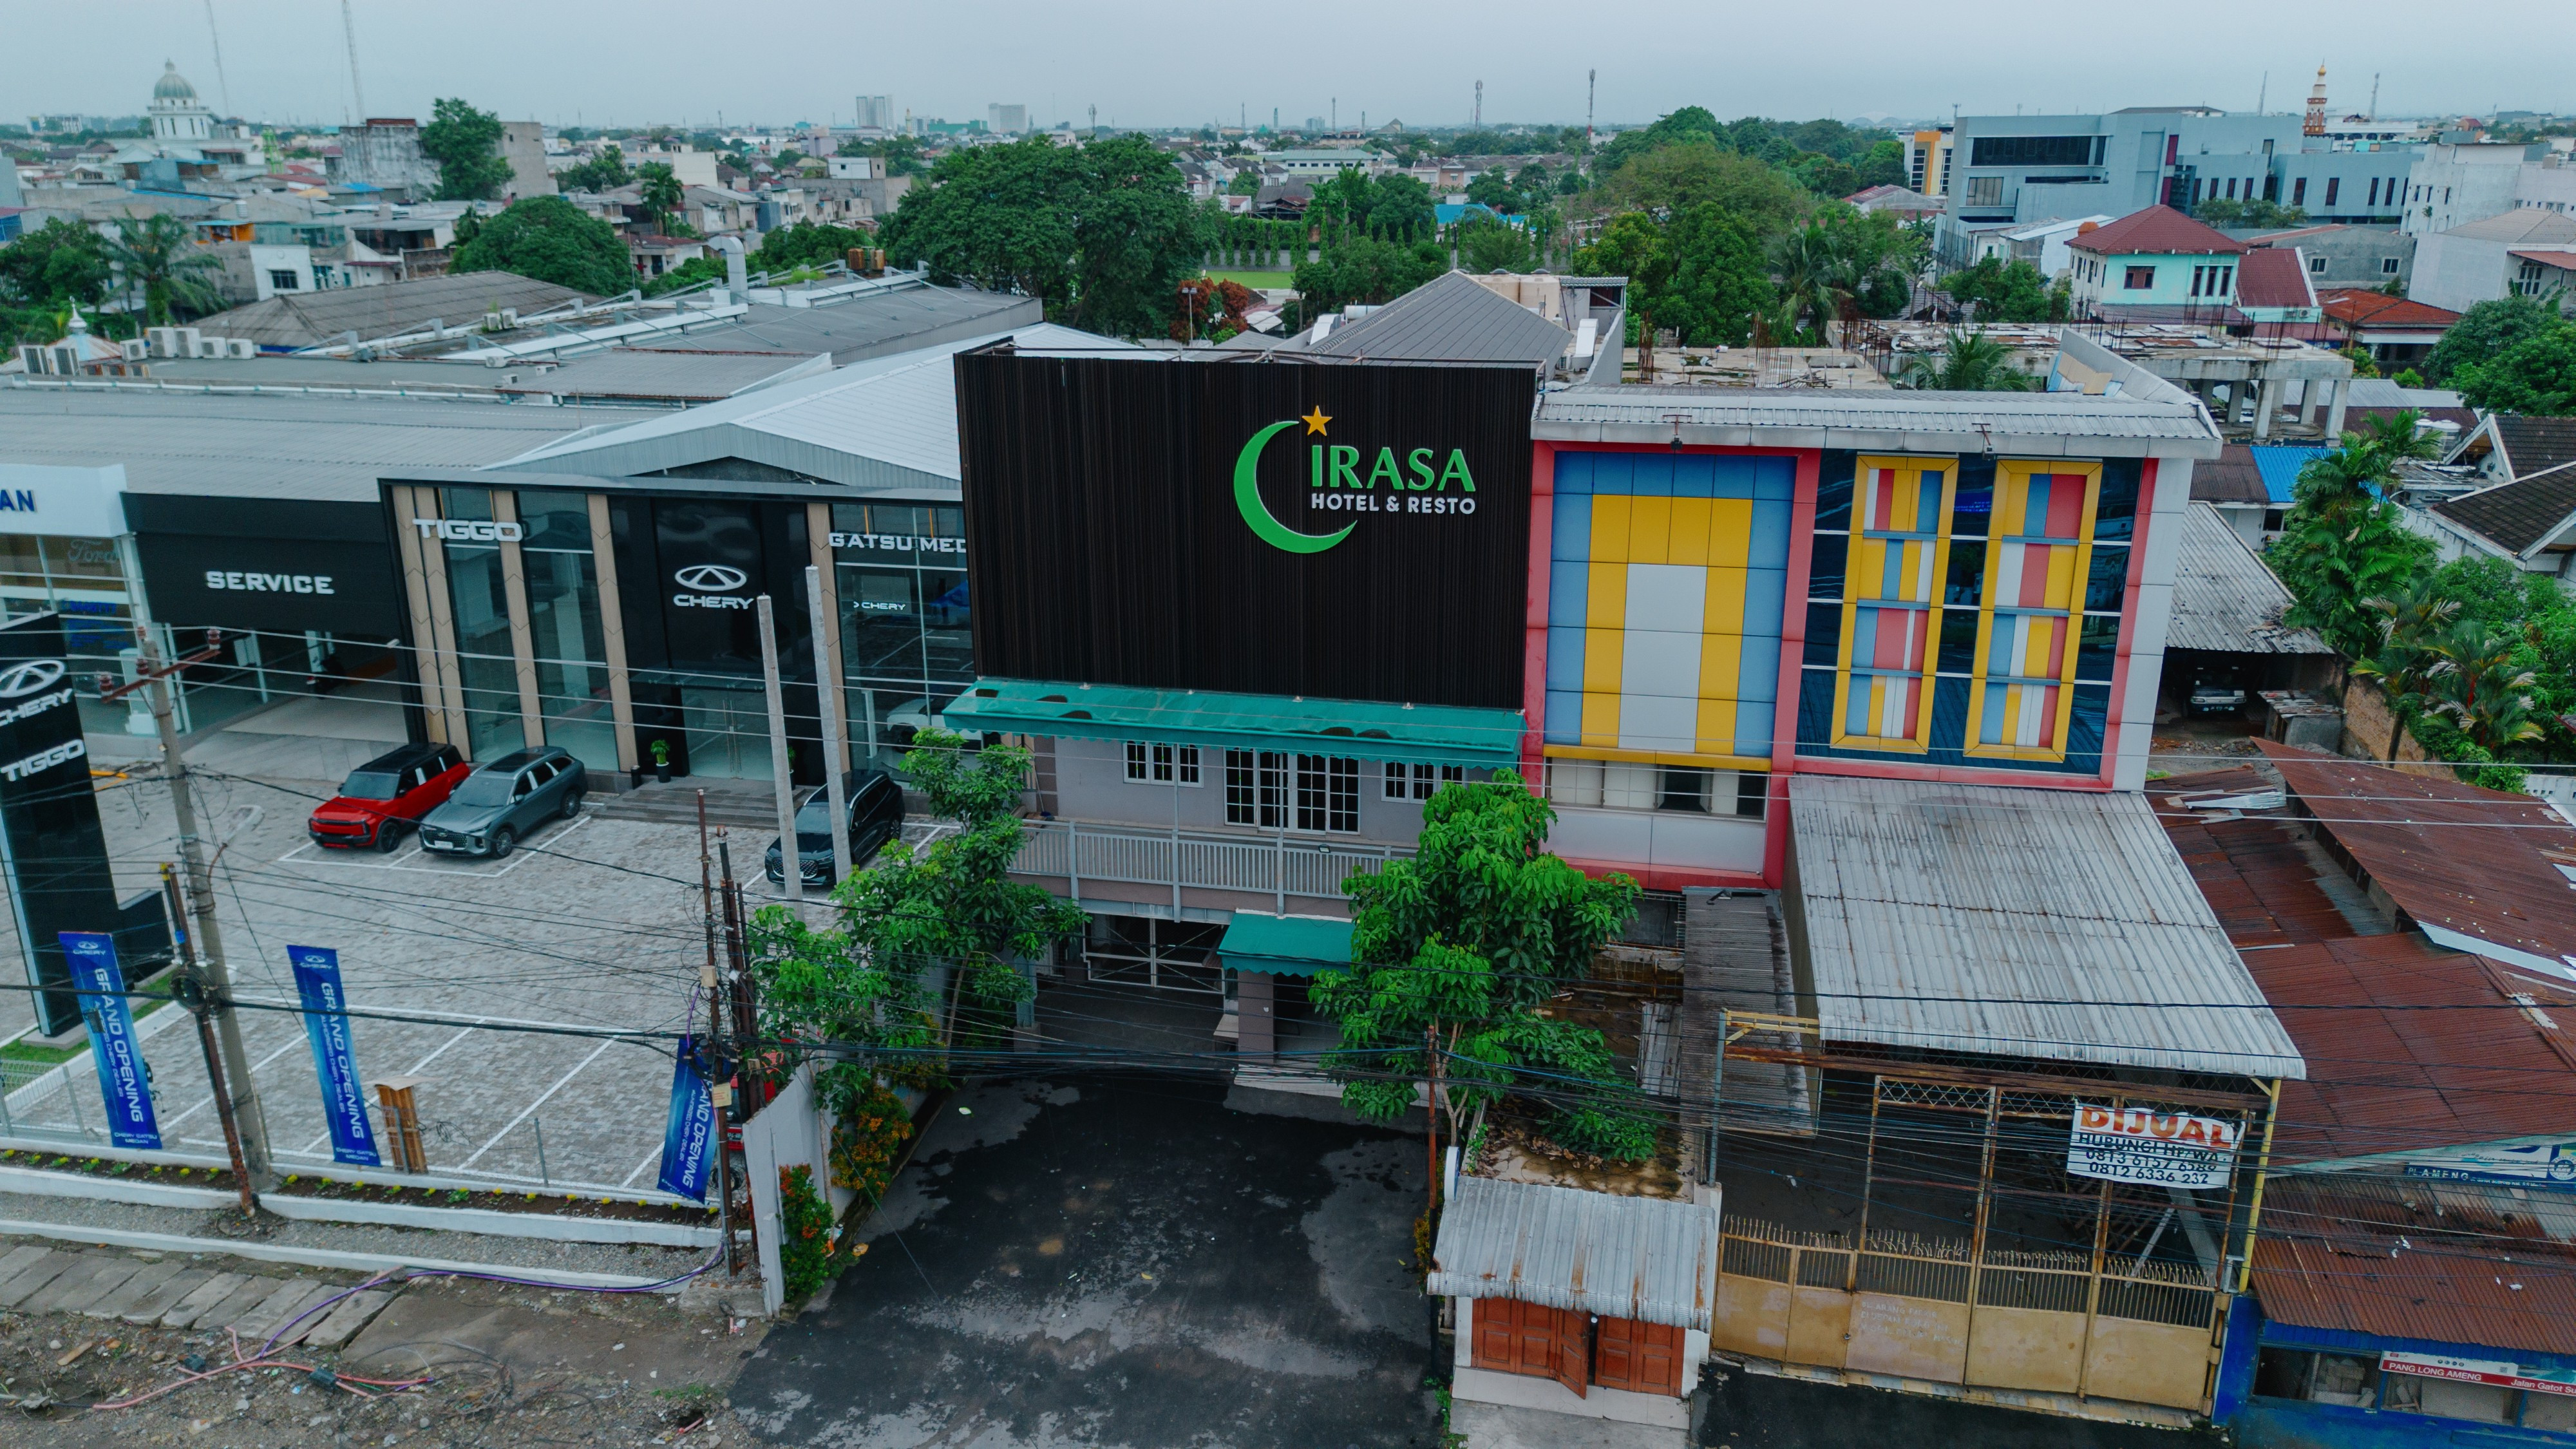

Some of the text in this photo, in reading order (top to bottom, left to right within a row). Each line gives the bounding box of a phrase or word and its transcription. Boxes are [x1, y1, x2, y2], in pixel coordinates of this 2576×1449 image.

[1311, 493, 1476, 515] HOTEL & RESTO
[412, 518, 524, 542] TIGGO
[828, 532, 913, 551] GATSU
[205, 571, 336, 594] SERVICE
[673, 594, 755, 610] CHERY
[861, 601, 906, 611] CHERY
[1, 739, 86, 782] TIGGO
[113, 1039, 144, 1122] OPENING
[337, 1055, 365, 1139] OPENING
[2081, 1106, 2232, 1148] DIJUAL
[682, 1122, 706, 1189] OPENING
[2089, 1162, 2209, 1184] 0812 6336 232
[2389, 1362, 2483, 1381] PANG LONG AMENG
[2511, 1379, 2535, 1388] Jalan
[2537, 1382, 2562, 1392] Gatot
